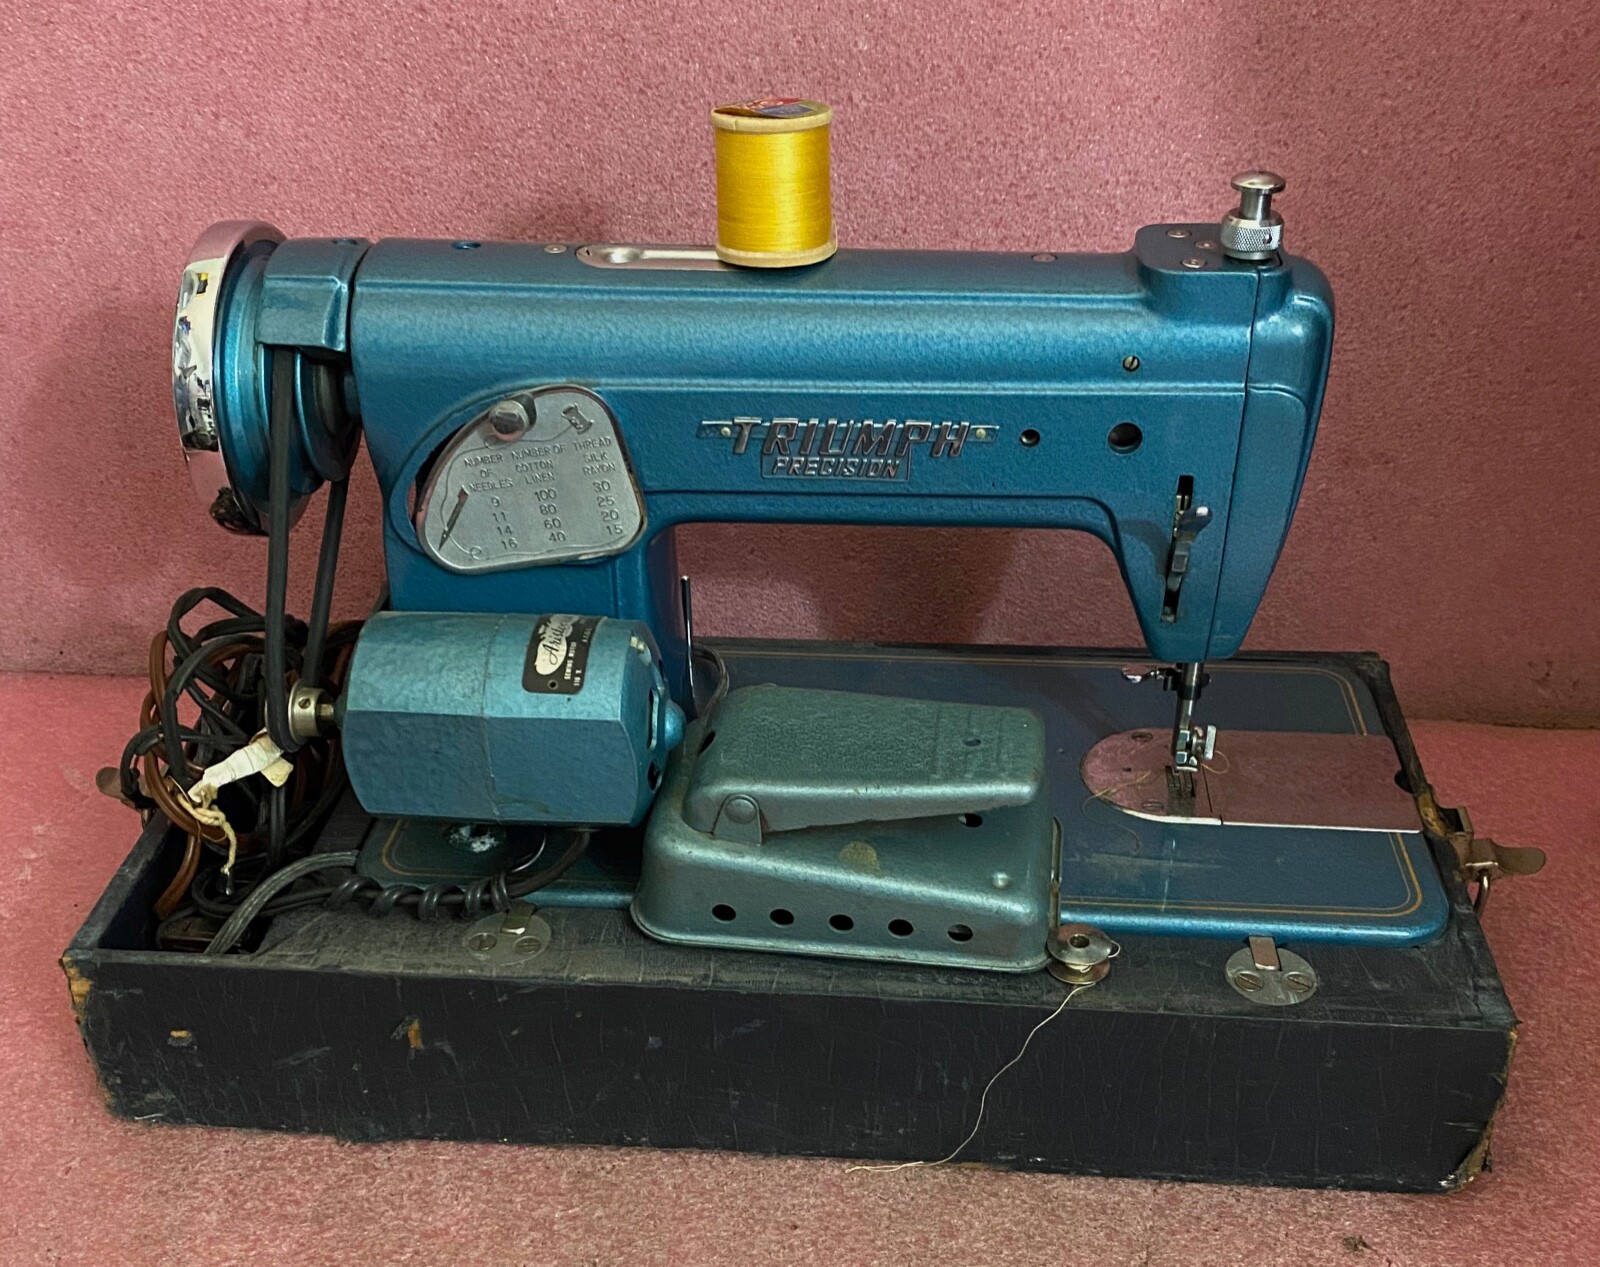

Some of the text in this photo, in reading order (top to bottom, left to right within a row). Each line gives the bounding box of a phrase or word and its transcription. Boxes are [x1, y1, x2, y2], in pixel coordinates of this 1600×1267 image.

[732, 417, 970, 457] TRIUMPH
[511, 436, 612, 461] NUMBER OF THREAD
[464, 453, 504, 467] NUMBER
[515, 452, 609, 473] COTTON SILK
[771, 457, 899, 478] PRECISION
[480, 468, 494, 479] OF
[525, 462, 616, 485] LINEN RAYON
[469, 478, 513, 493] NEEDLES
[491, 480, 611, 508] 9 100 30
[493, 495, 615, 523] 11 80 25
[544, 517, 561, 529] 60
[601, 508, 619, 521] 20
[502, 537, 518, 550] 16
[606, 523, 623, 536] 15
